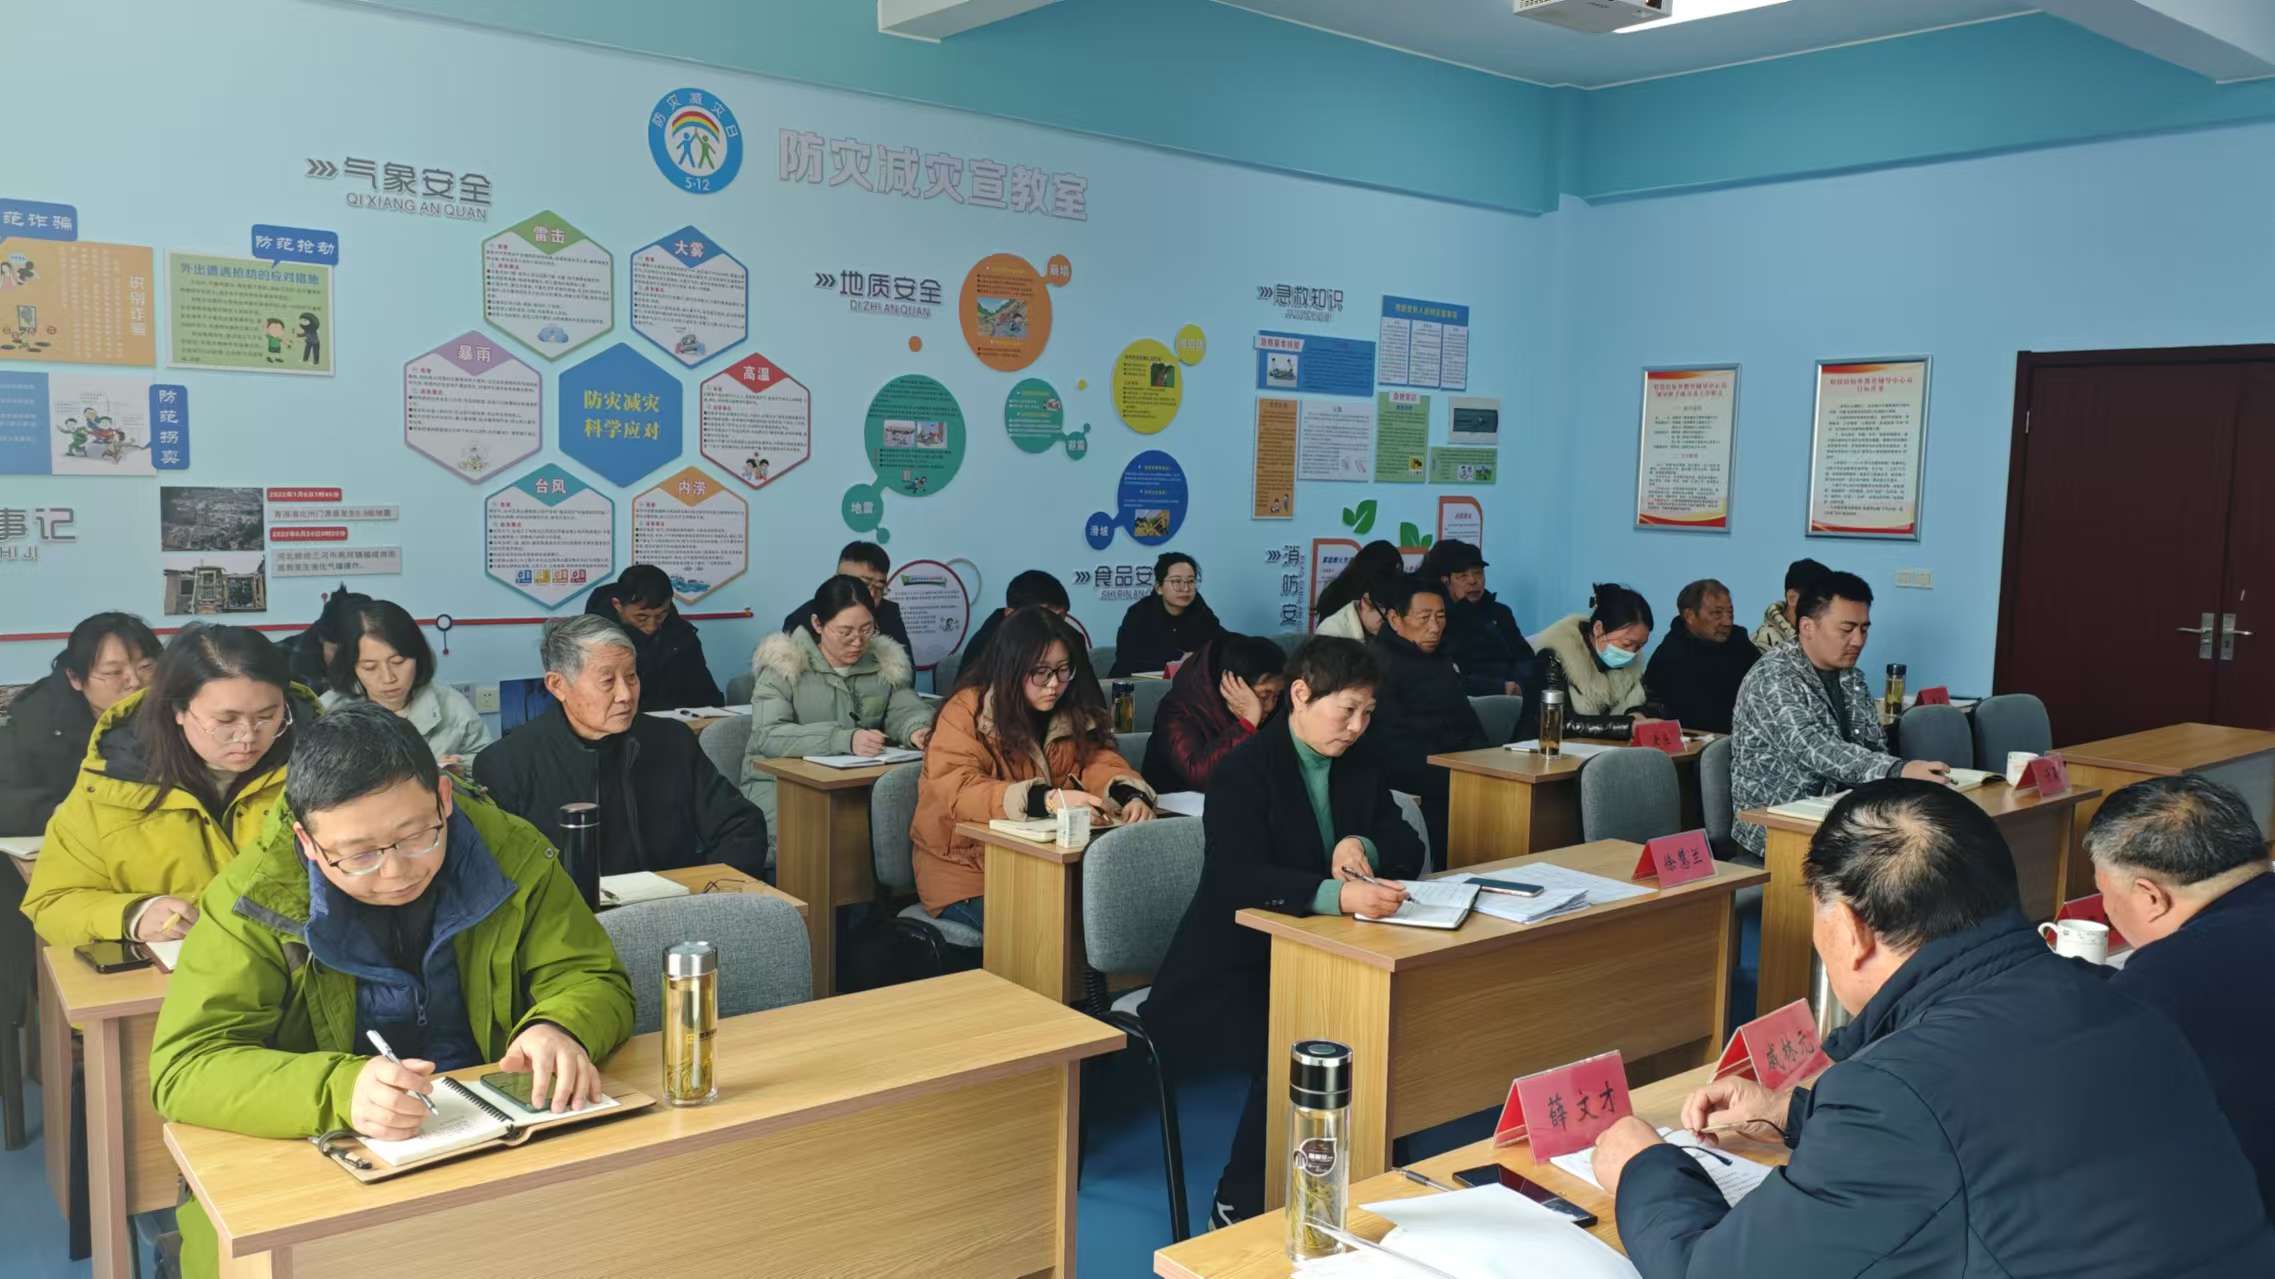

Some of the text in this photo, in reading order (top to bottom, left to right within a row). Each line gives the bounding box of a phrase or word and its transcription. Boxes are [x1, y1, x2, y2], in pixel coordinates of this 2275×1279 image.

[343, 156, 492, 205] 气象安全
[778, 128, 1088, 222] 防灾减灾宣教室
[346, 192, 488, 221] QI XIANG AN QUAN
[839, 269, 942, 305] 地质安全
[1274, 284, 1344, 312] 急救知识
[457, 344, 492, 363] 暴雨
[743, 366, 771, 382] 高温
[583, 389, 660, 413] 防灾减灾
[584, 417, 660, 441] 科学应对
[535, 478, 567, 495] 台风
